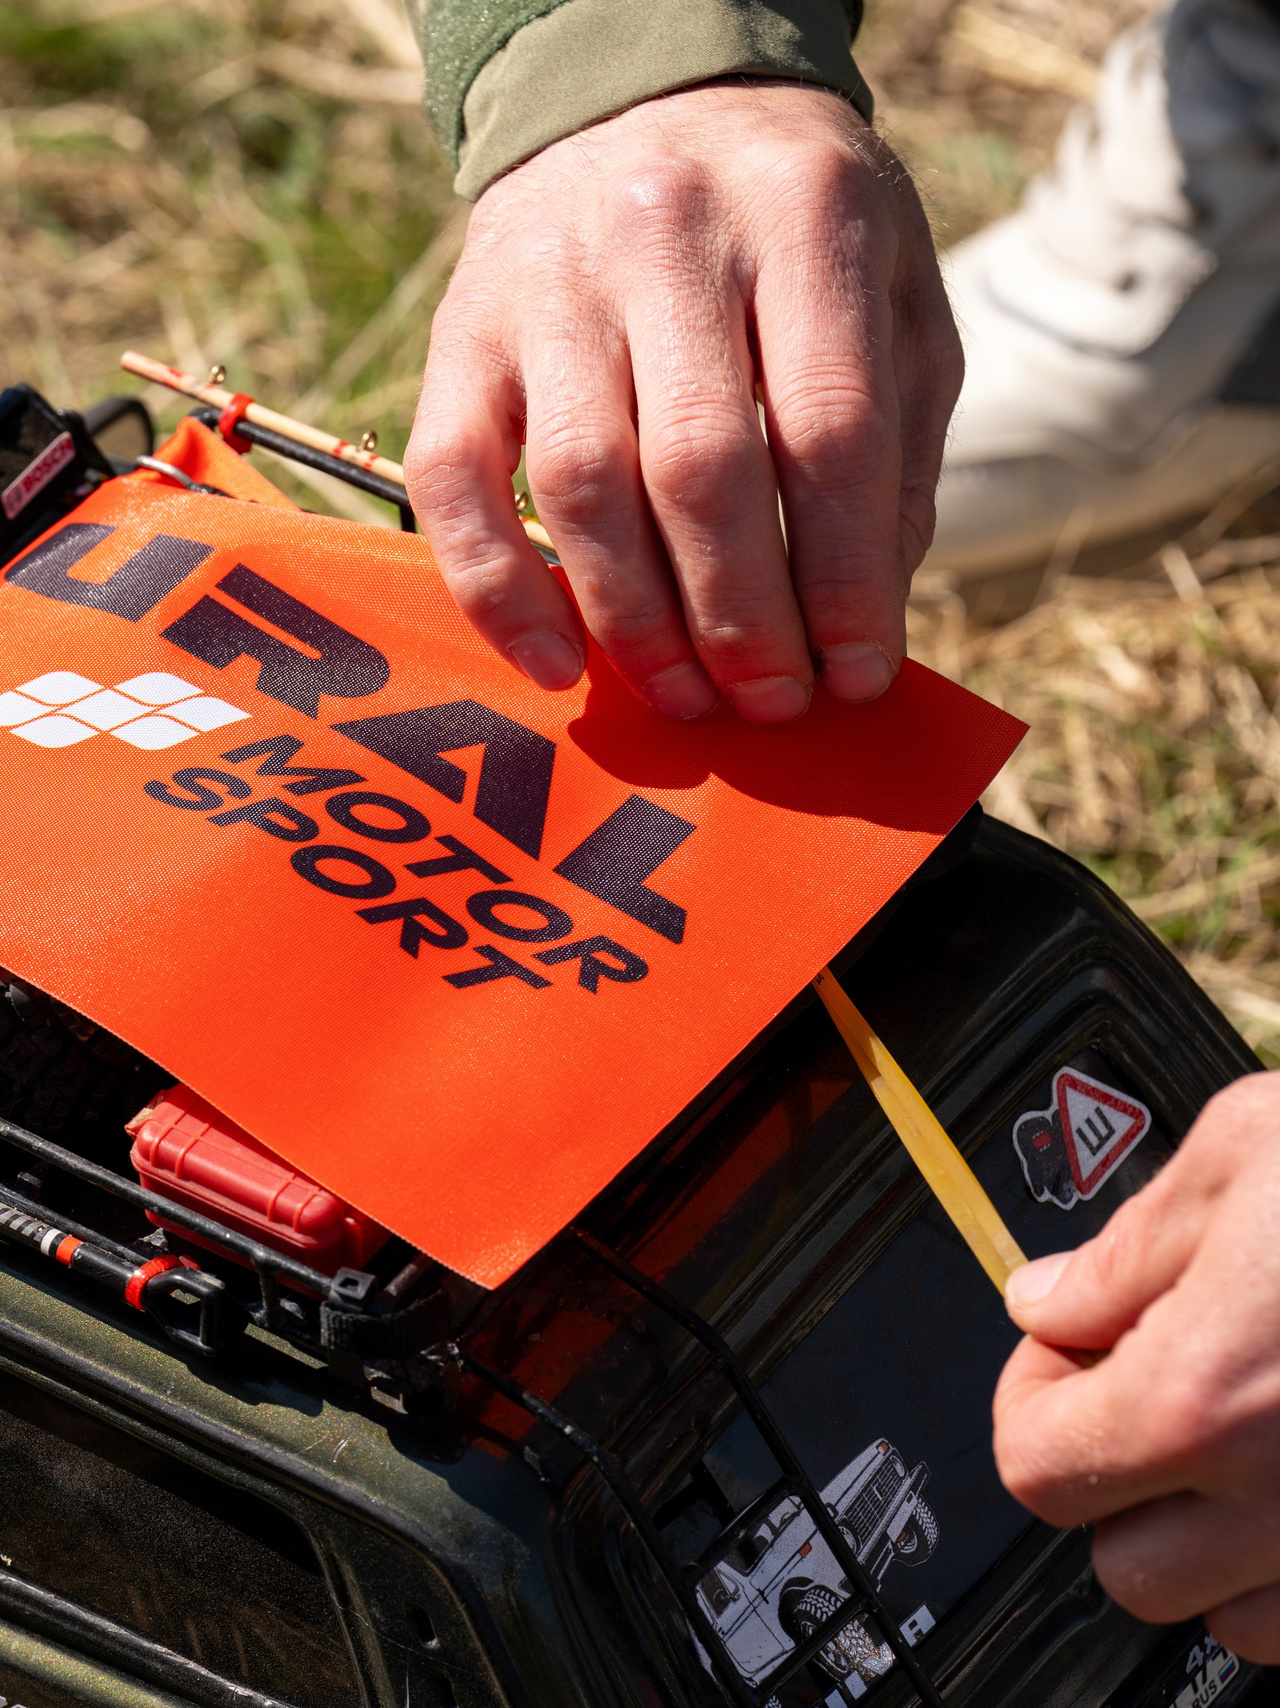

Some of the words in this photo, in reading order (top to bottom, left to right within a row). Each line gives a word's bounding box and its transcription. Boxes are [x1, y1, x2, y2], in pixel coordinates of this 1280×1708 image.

[23, 437, 74, 493] BOSCH
[4, 523, 696, 945] URAL
[143, 767, 554, 989] SPORT
[220, 734, 650, 994] MOTOR
